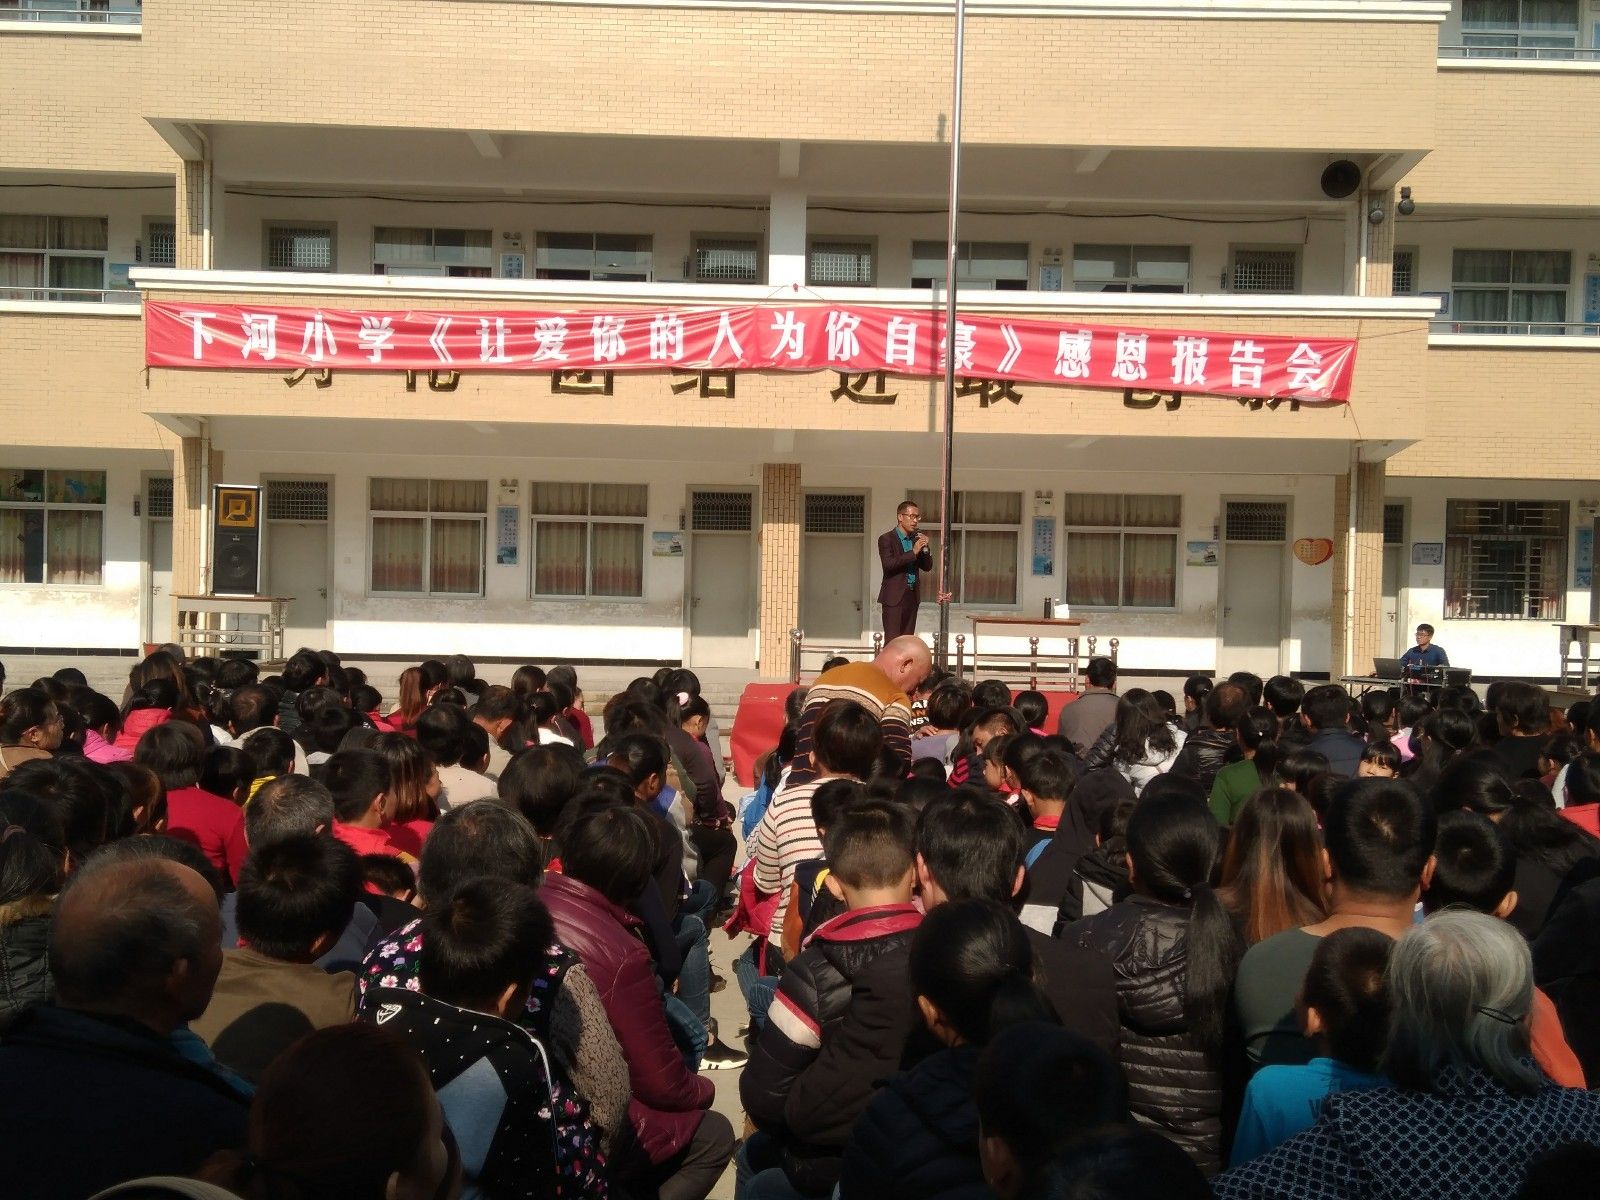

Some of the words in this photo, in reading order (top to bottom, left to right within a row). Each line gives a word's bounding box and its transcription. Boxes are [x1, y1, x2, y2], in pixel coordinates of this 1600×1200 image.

[179, 310, 1324, 391] 下河小学《让爱你的人为你自豪》感恩报告会
